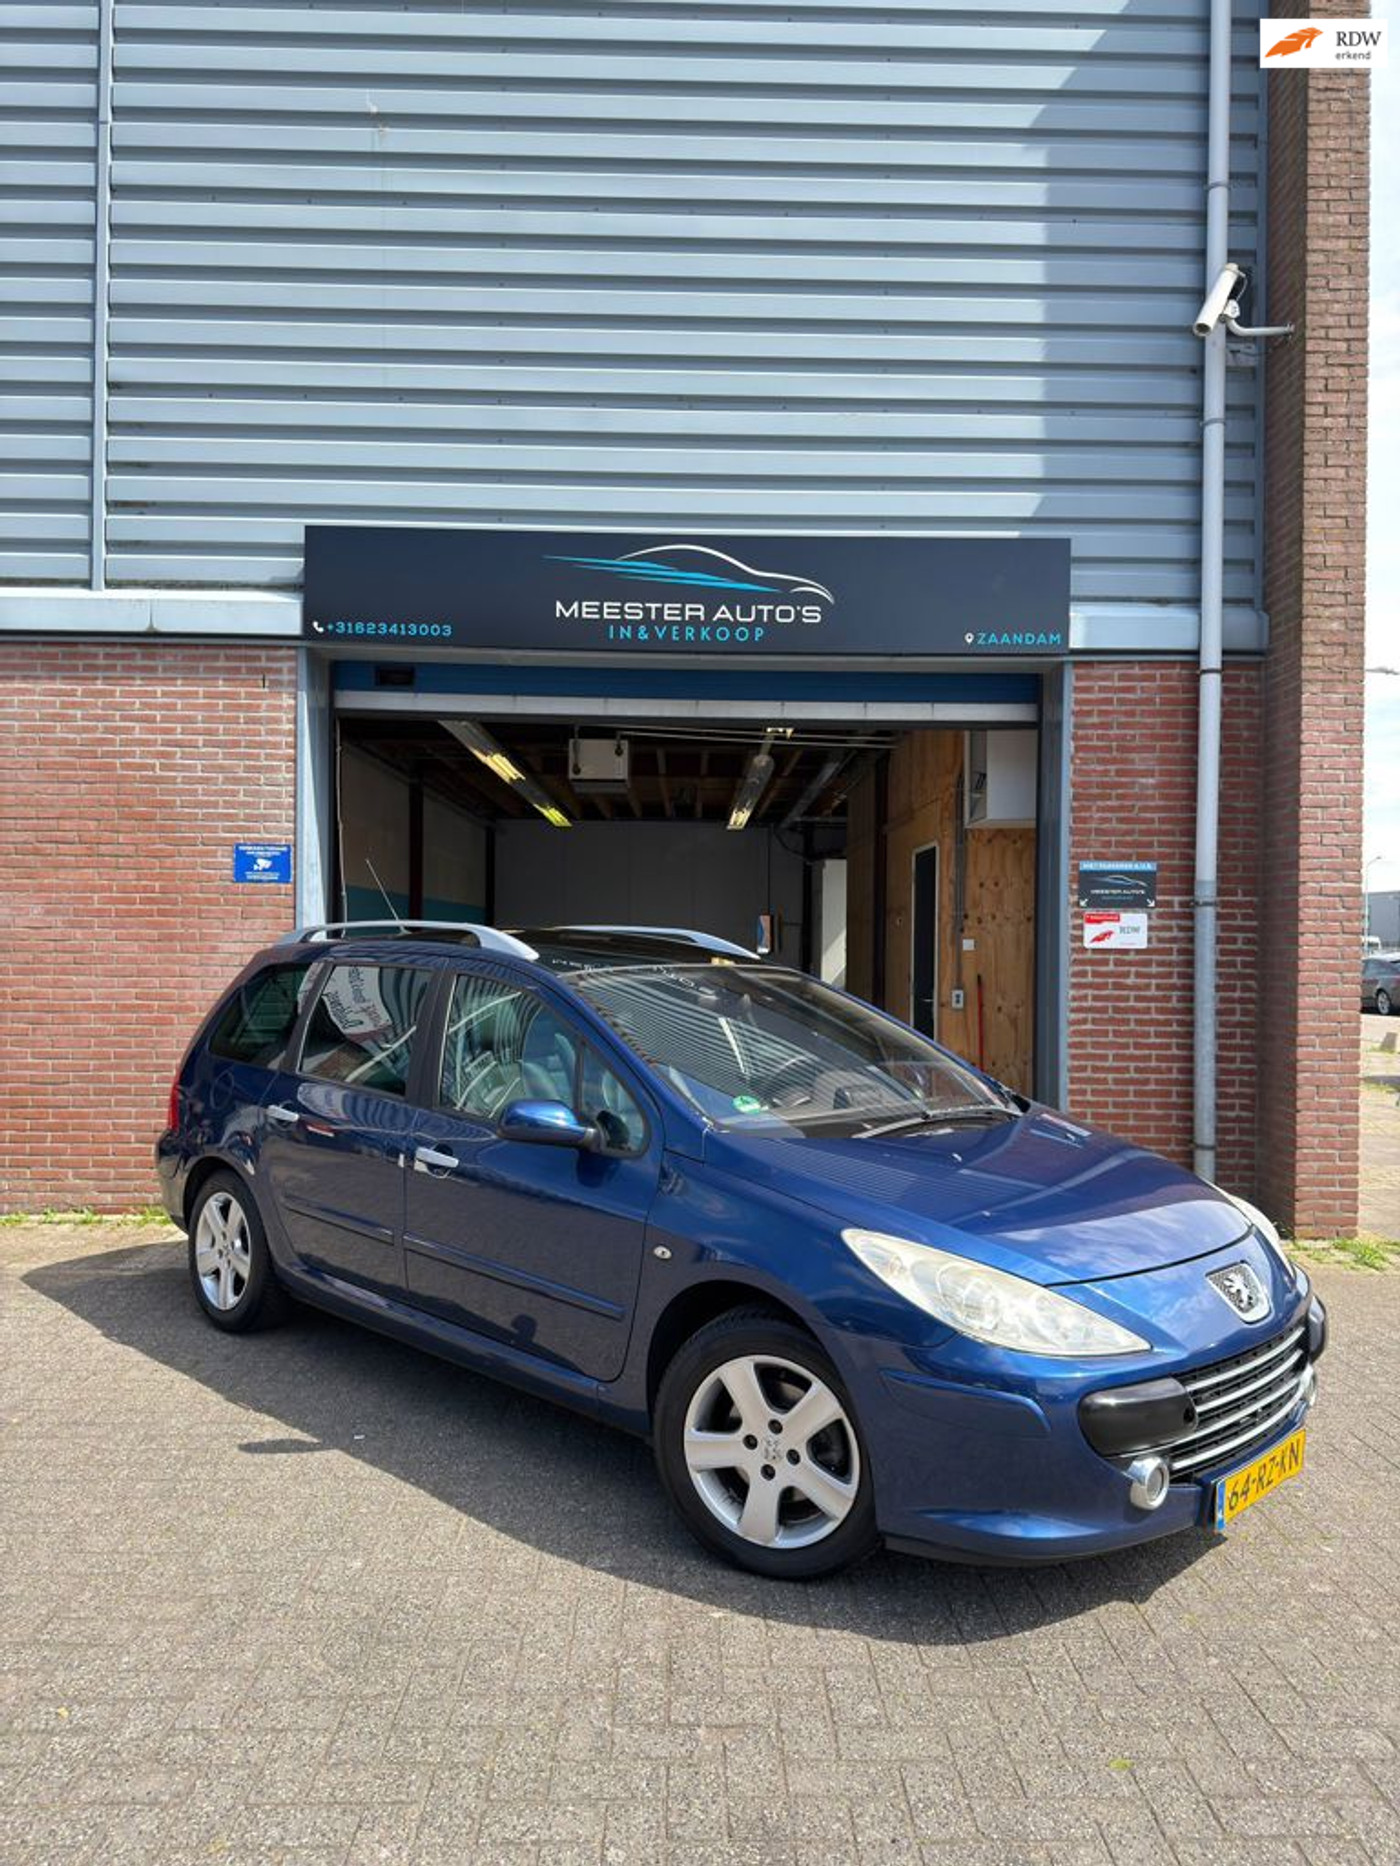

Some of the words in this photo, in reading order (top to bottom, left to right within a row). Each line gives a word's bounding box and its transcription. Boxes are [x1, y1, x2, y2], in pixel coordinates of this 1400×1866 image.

[555, 600, 704, 621] MEESTER
[712, 604, 822, 623] AUTO'S
[977, 632, 1061, 645] ZAANDAM
[1228, 1438, 1301, 1511] 64-RZ-KN
